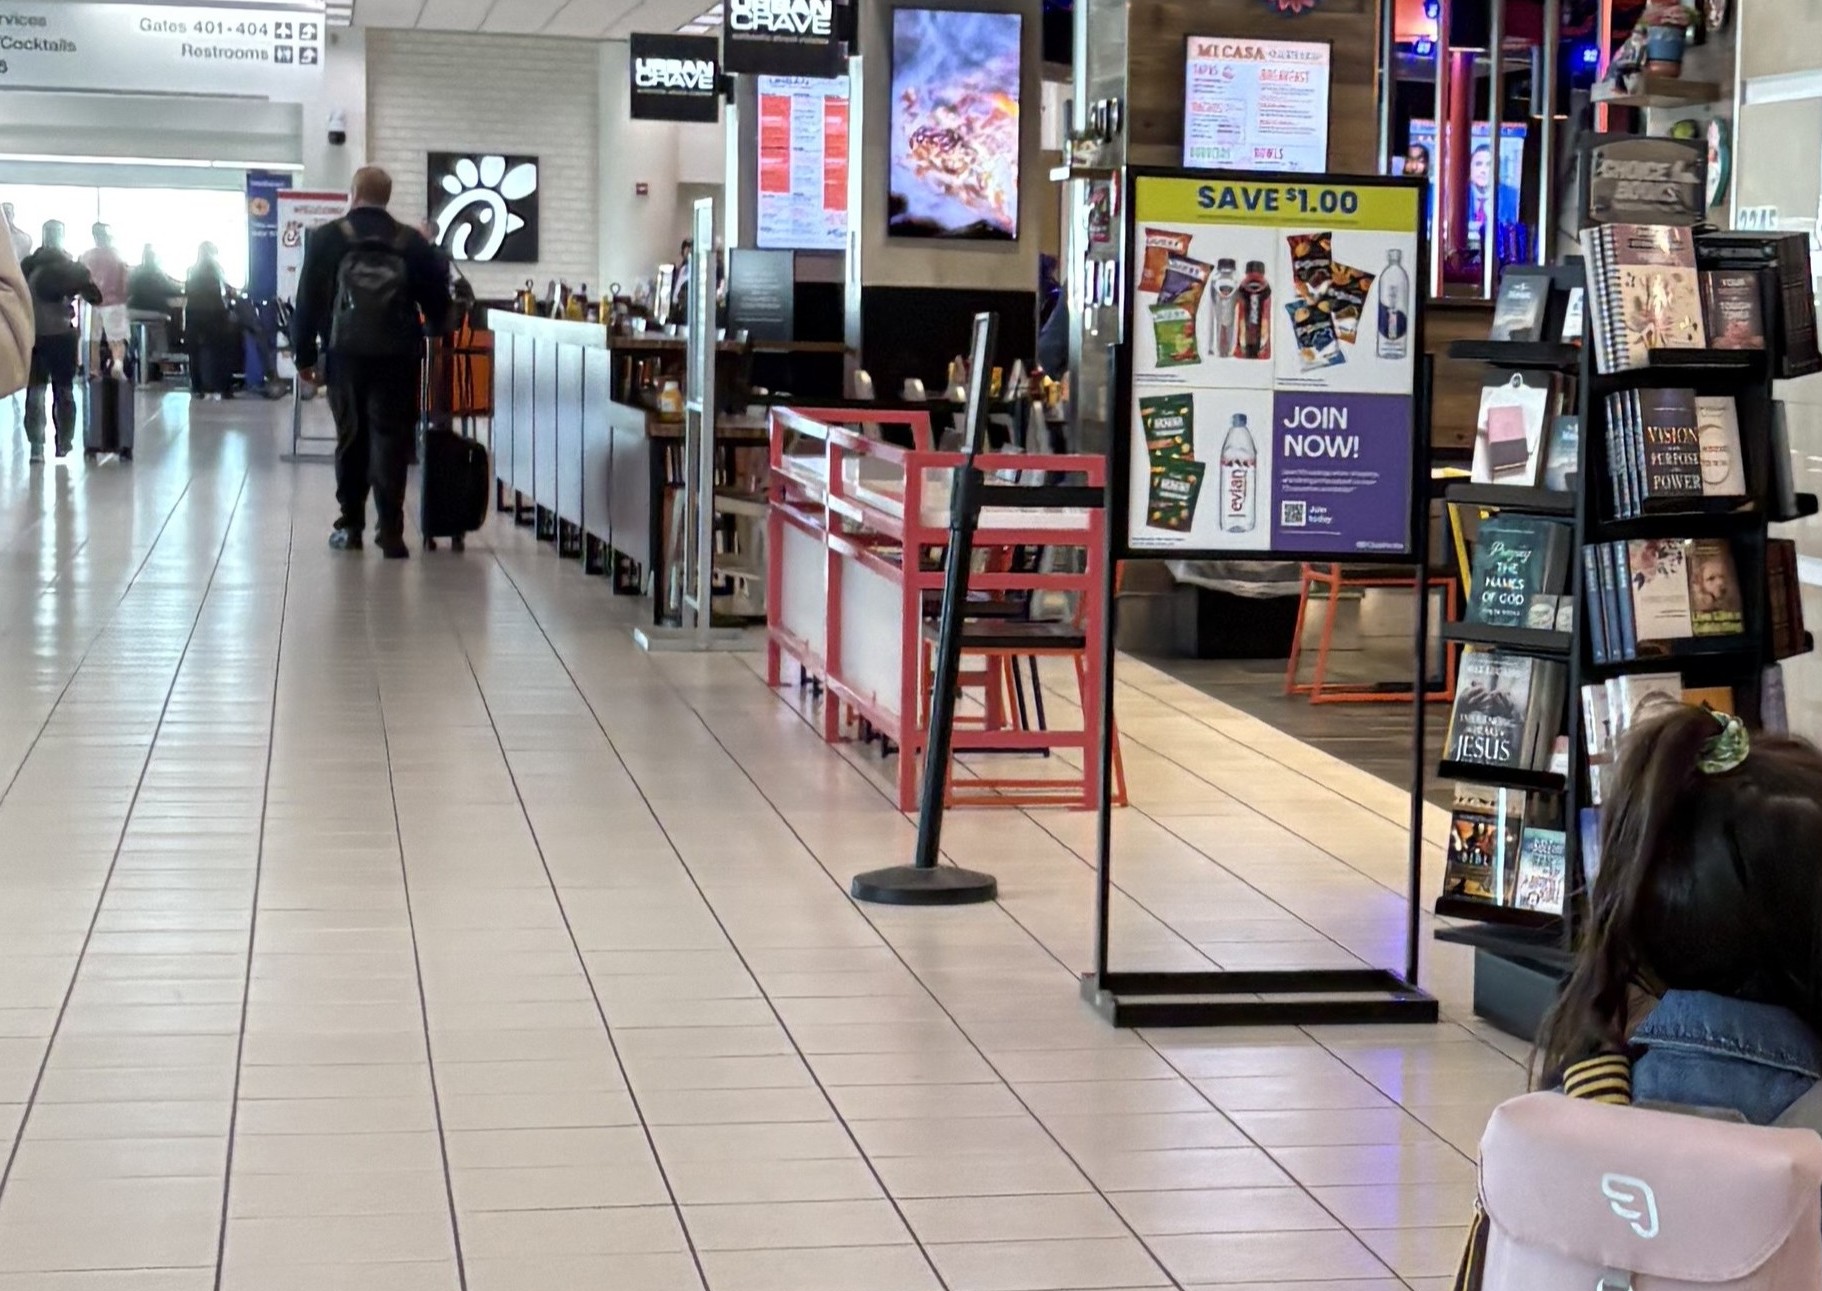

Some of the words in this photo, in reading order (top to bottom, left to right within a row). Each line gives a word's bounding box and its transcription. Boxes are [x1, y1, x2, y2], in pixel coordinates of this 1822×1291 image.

[139, 18, 188, 34] Gates
[193, 20, 269, 37] 401-404
[730, 11, 832, 35] CRAVE
[182, 43, 269, 61] Restrooms
[1198, 43, 1218, 58] MI
[1222, 44, 1265, 60] CASA
[636, 58, 714, 76] URBAN
[636, 71, 714, 90] CRAVE
[1196, 185, 1280, 212] SAVE
[1286, 187, 1359, 214] $1.00
[1283, 405, 1348, 430] JOIN
[1648, 426, 1698, 444] VISION
[1283, 434, 1360, 458] NOW!
[1229, 468, 1248, 513] evian
[1653, 474, 1702, 490] POWER
[1485, 576, 1525, 591] NAMES
[1482, 591, 1496, 604] OF
[1499, 592, 1525, 606] GOD
[1456, 733, 1511, 762] JESUS
